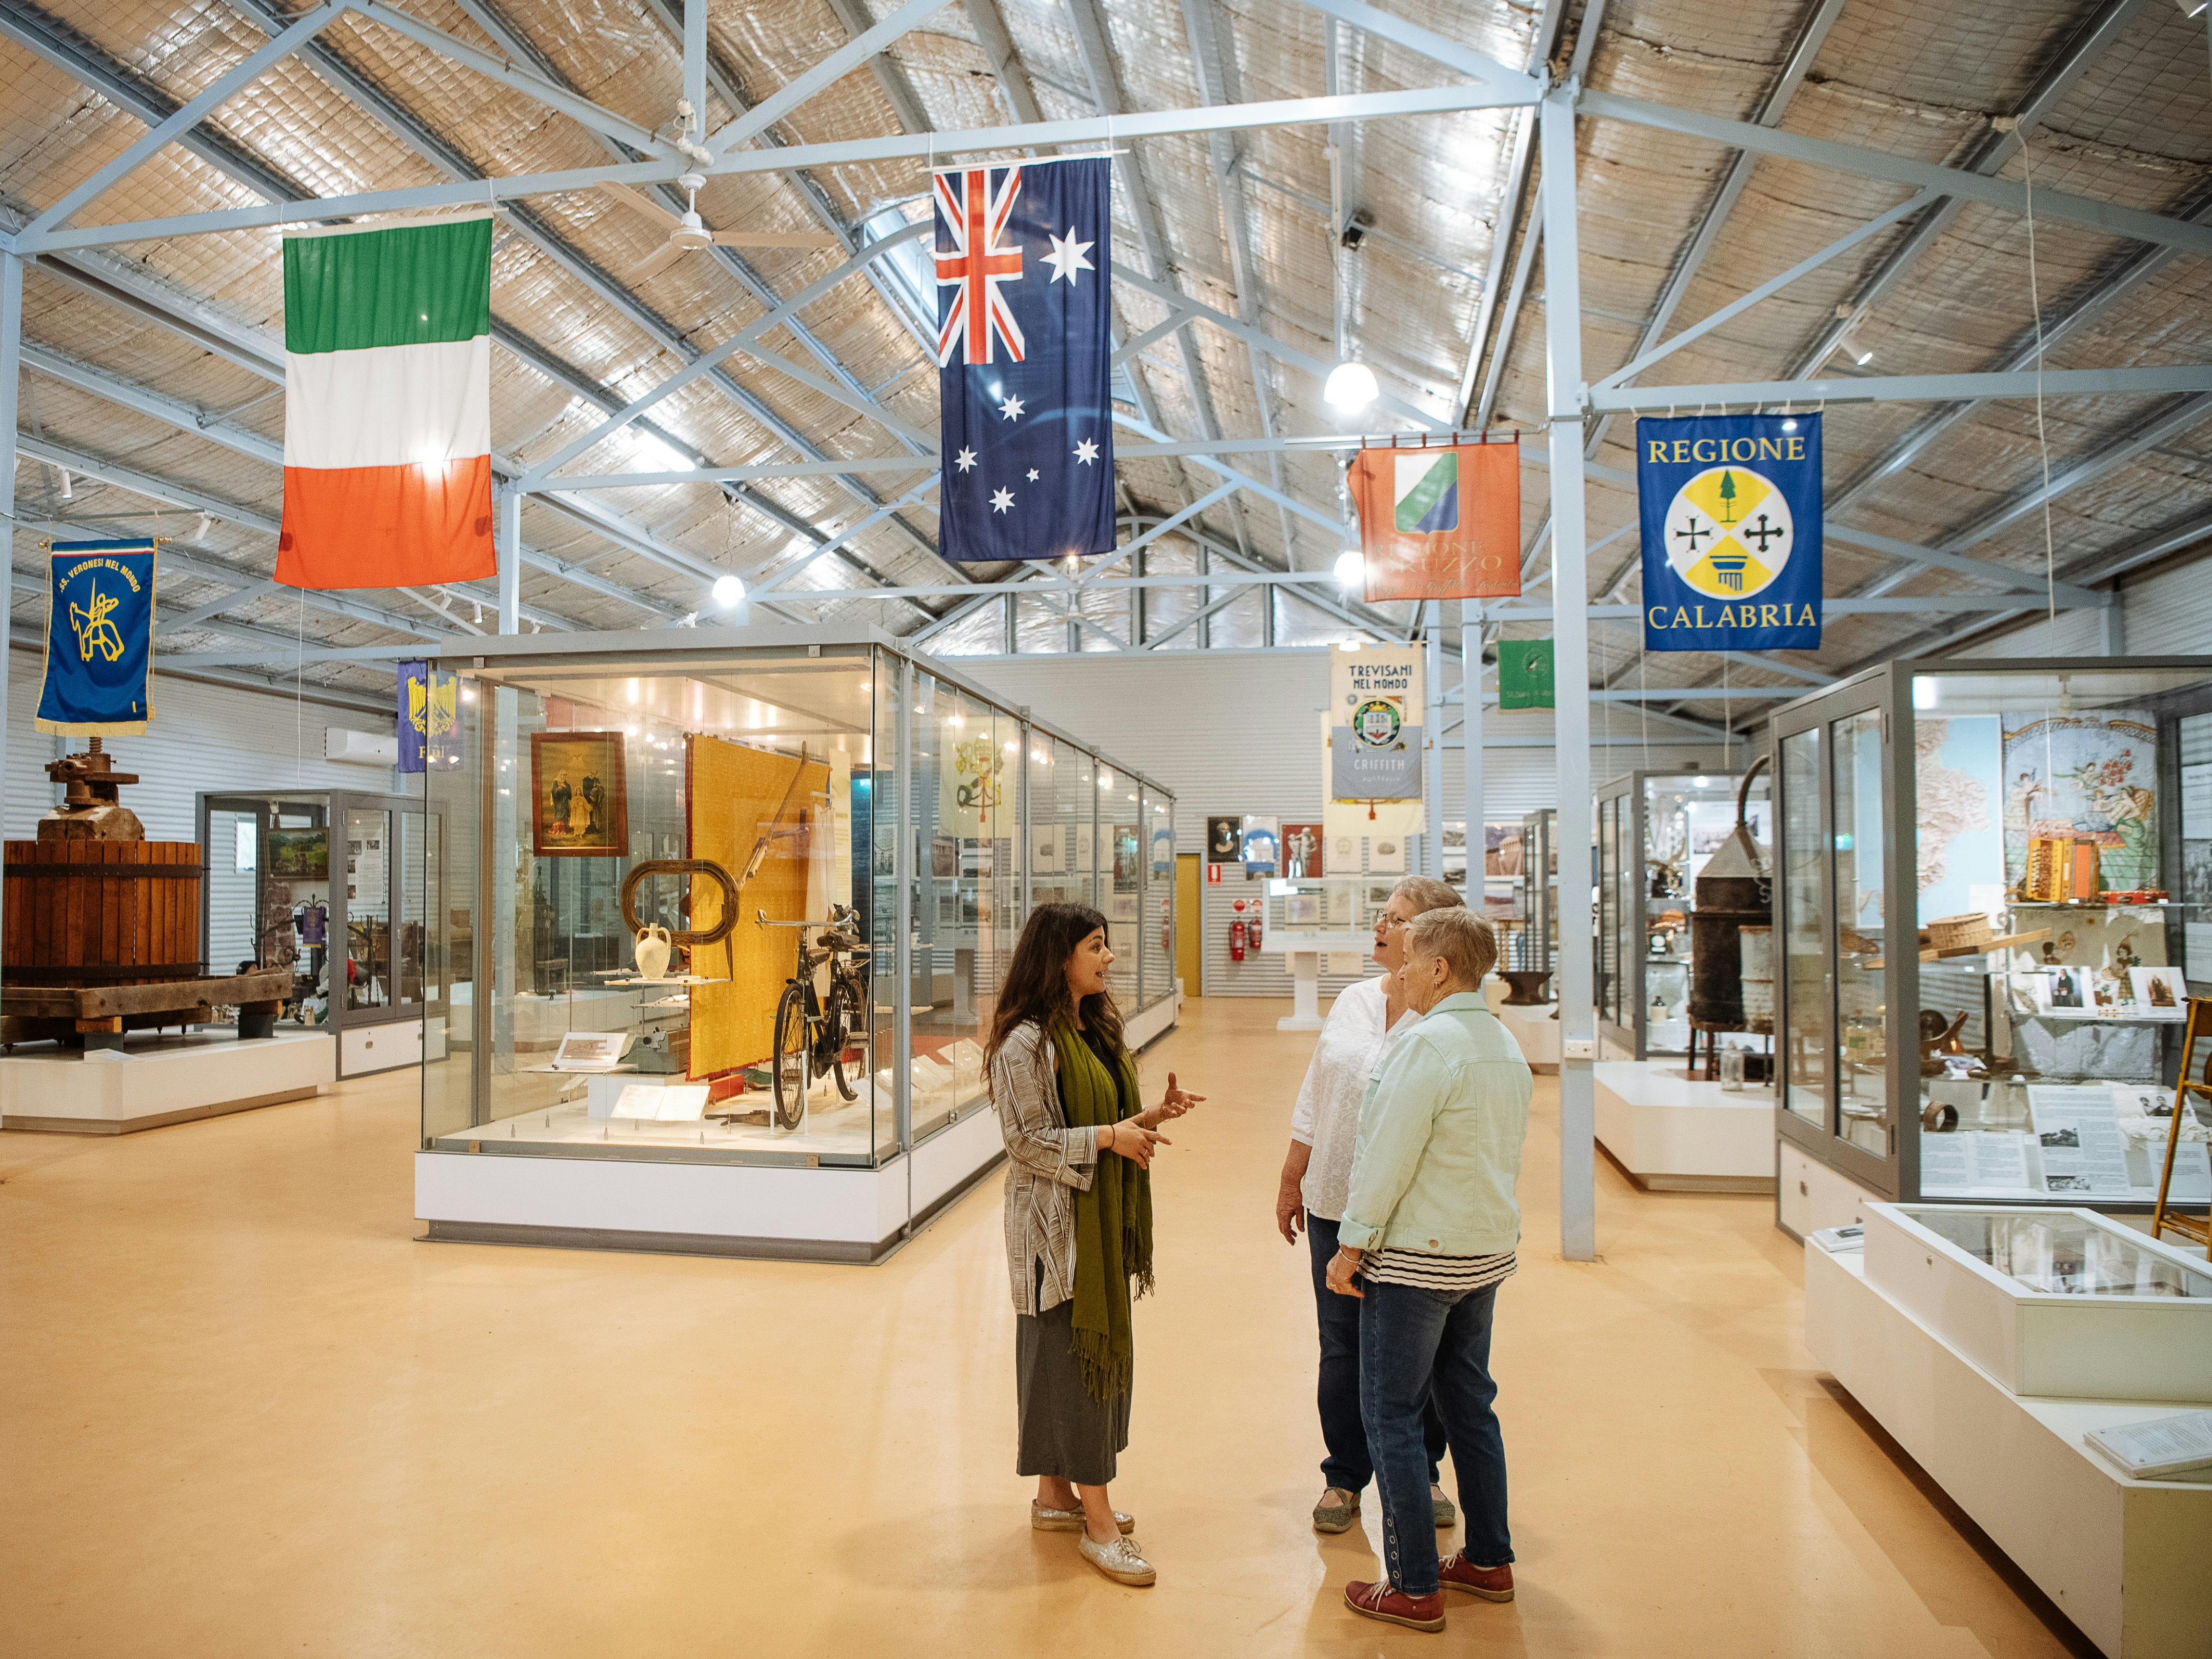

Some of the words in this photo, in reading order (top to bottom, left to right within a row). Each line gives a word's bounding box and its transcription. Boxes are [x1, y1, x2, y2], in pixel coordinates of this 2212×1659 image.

[1648, 436, 1805, 463] REGIONE
[1373, 540, 1483, 557] RIONE
[1387, 555, 1502, 573] RUZZO
[59, 577, 70, 593] SS.
[67, 558, 104, 578] VERONESI
[105, 559, 120, 572] NEL
[120, 565, 140, 593] MONDO
[1649, 603, 1817, 629] CALABRIA
[1349, 665, 1412, 677] TREVISANI
[1353, 679, 1371, 689] NEL
[1374, 678, 1408, 689] MONDO
